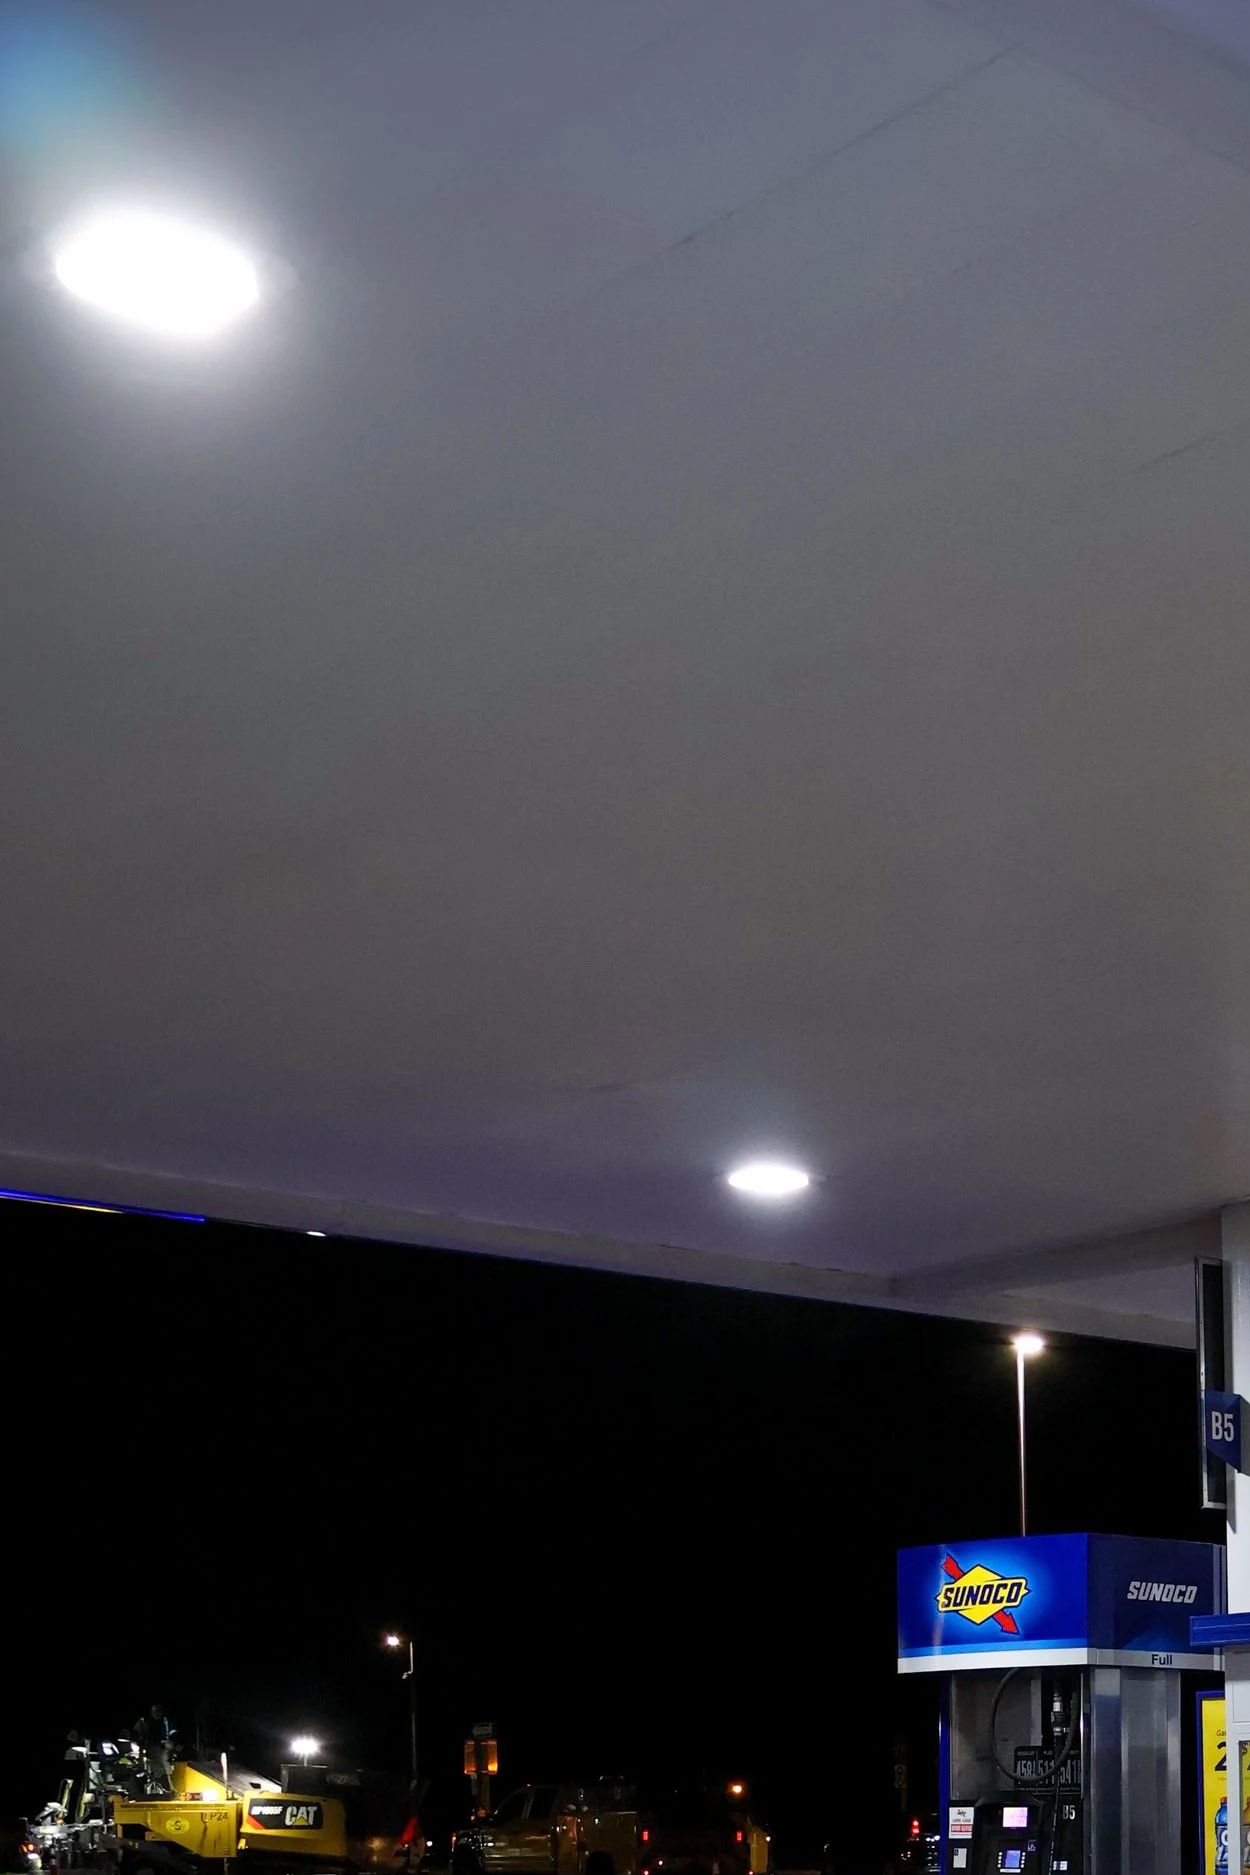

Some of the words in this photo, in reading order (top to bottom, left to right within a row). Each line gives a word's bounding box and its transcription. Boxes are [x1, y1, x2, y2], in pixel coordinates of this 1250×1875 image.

[1211, 1411, 1235, 1442] B5
[942, 1582, 1022, 1607] SUNOCO
[1127, 1581, 1198, 1604] SUNOCO
[1151, 1654, 1173, 1666] Full
[285, 1806, 318, 1826] CAT
[1063, 1805, 1076, 1820] B5
